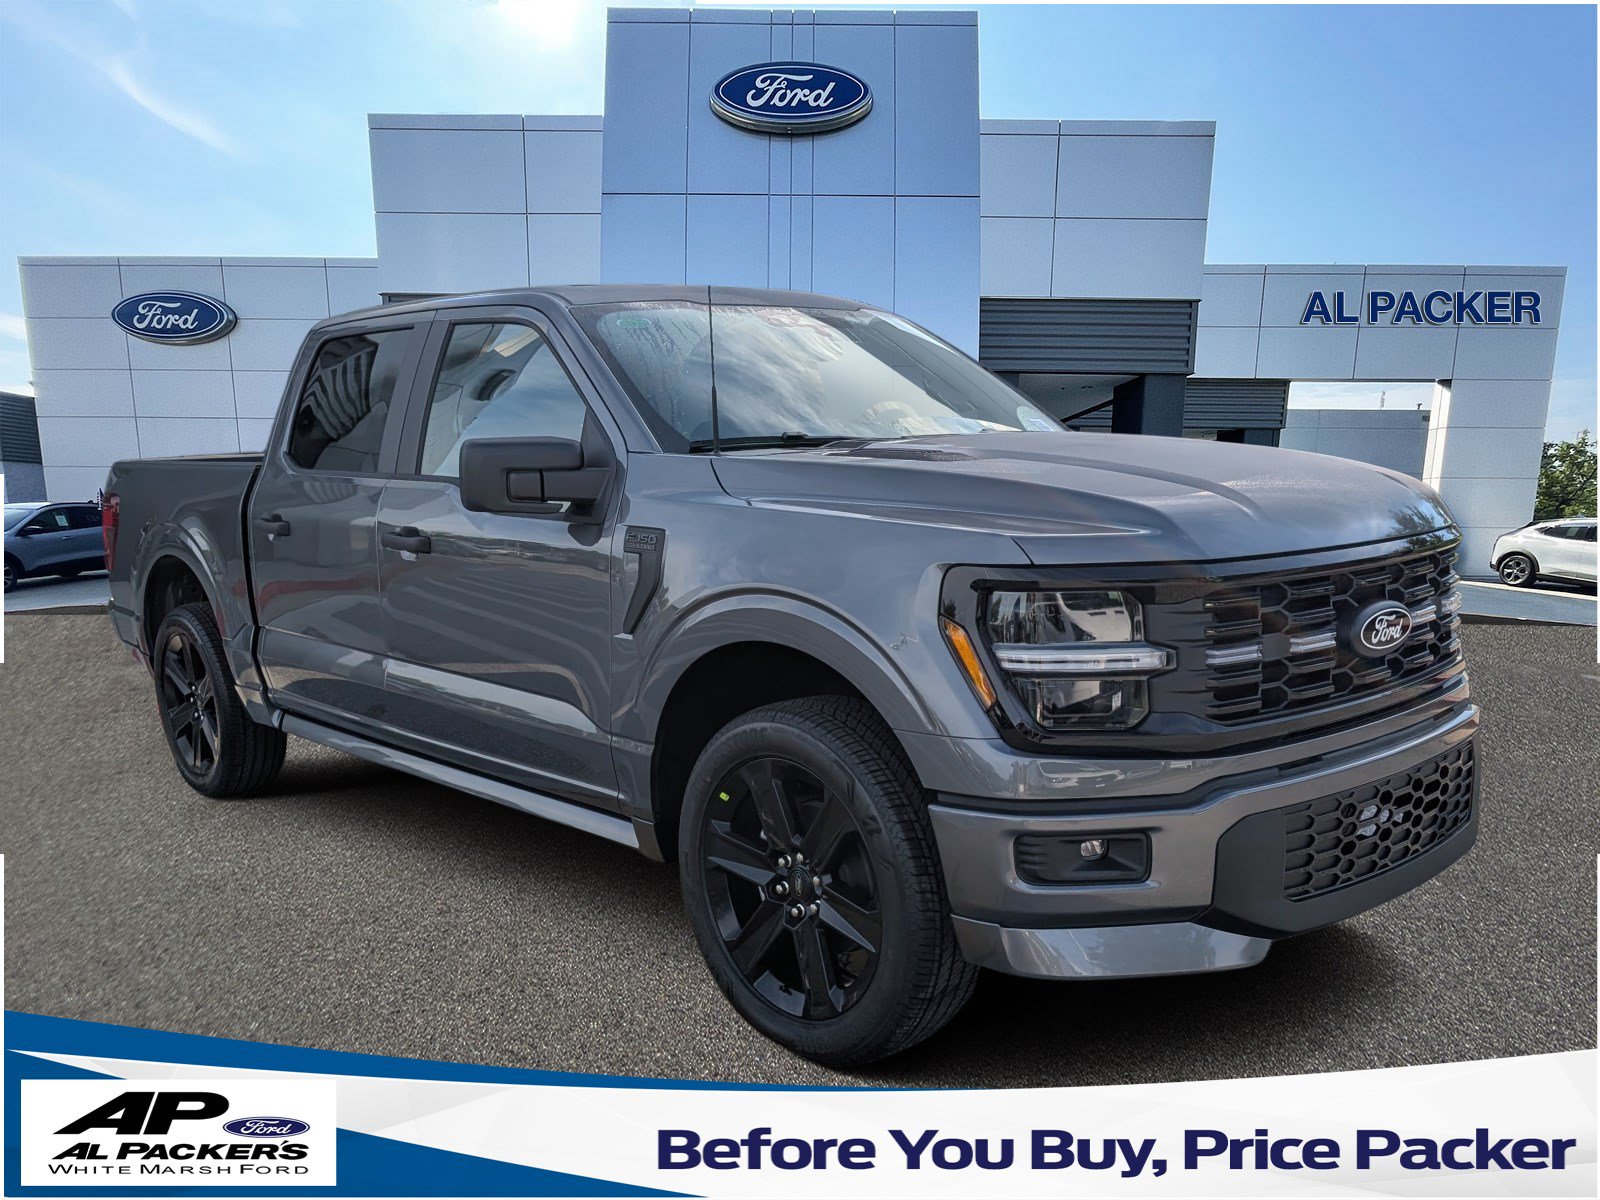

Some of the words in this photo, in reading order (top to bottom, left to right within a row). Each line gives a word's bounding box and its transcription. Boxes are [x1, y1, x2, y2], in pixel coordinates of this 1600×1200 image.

[746, 73, 836, 107] Ford
[133, 301, 199, 329] Ford
[1302, 290, 1360, 324] AL
[1368, 290, 1542, 325] PACKER
[1371, 614, 1403, 644] Ford
